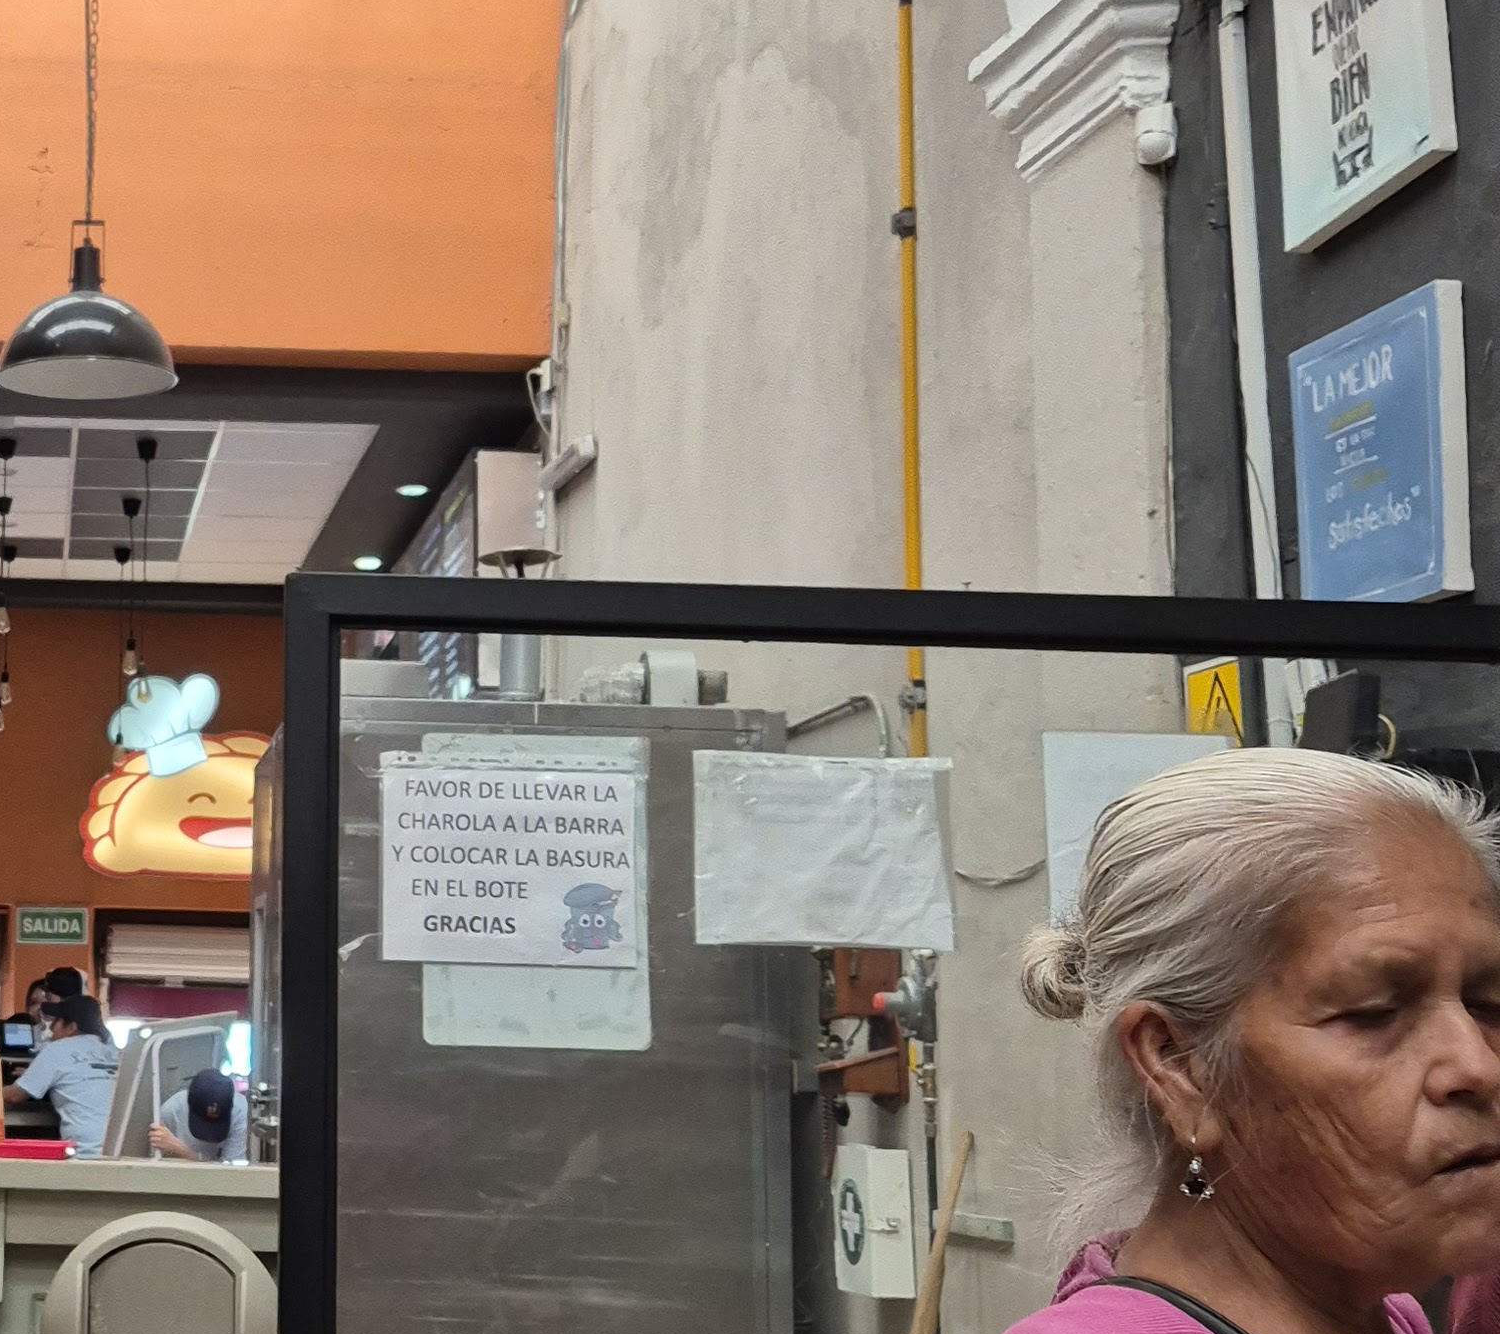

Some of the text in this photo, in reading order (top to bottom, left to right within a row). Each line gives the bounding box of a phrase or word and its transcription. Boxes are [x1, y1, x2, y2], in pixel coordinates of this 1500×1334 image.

[1329, 52, 1371, 125] BIEN
[1338, 343, 1394, 401] MEJOR
[405, 779, 618, 802] FAVOR DE LLEVAR LA
[398, 812, 625, 835] CHAROLA A LA BARRA
[392, 845, 630, 868] Y COLOCAR LA BASURA
[412, 878, 528, 899] EN EL BOTE
[22, 916, 81, 934] SALIDA
[423, 914, 516, 934] GRACIAS
